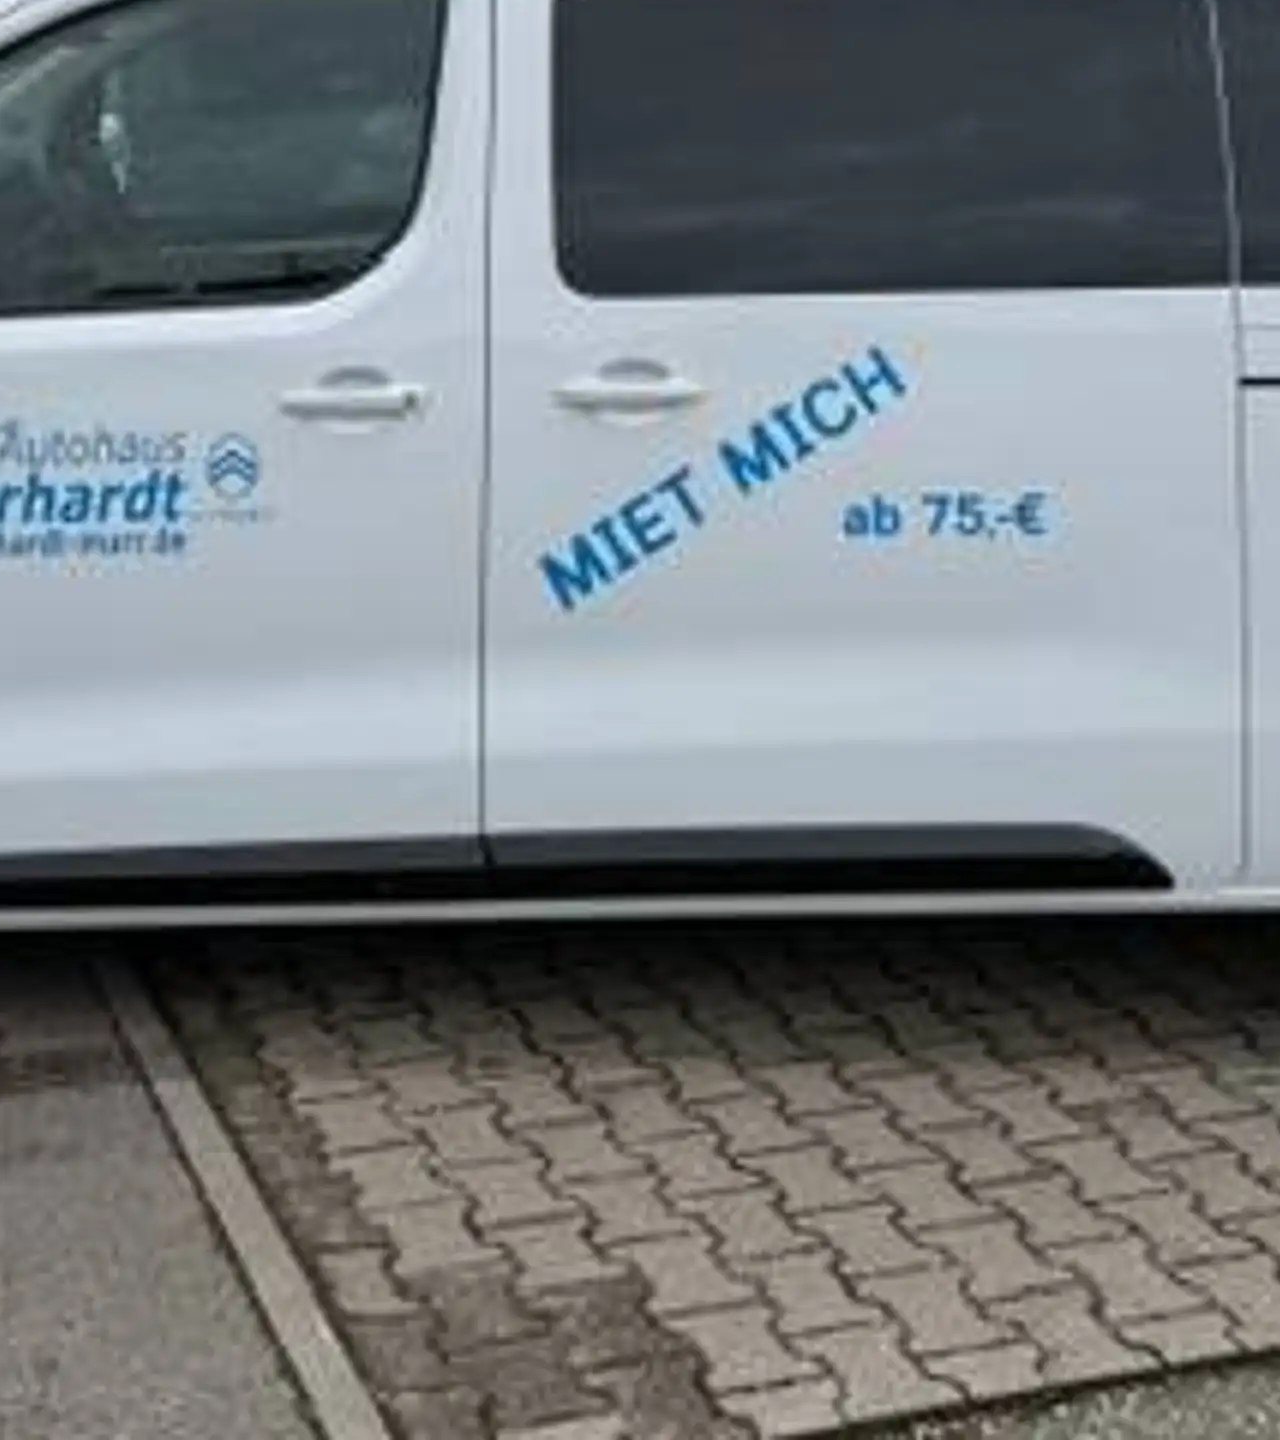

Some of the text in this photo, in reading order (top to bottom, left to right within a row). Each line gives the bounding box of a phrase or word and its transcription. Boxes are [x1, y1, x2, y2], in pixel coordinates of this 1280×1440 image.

[0, 422, 188, 468] Autohaus
[540, 344, 909, 611] MIET MICH
[842, 495, 903, 536] ab
